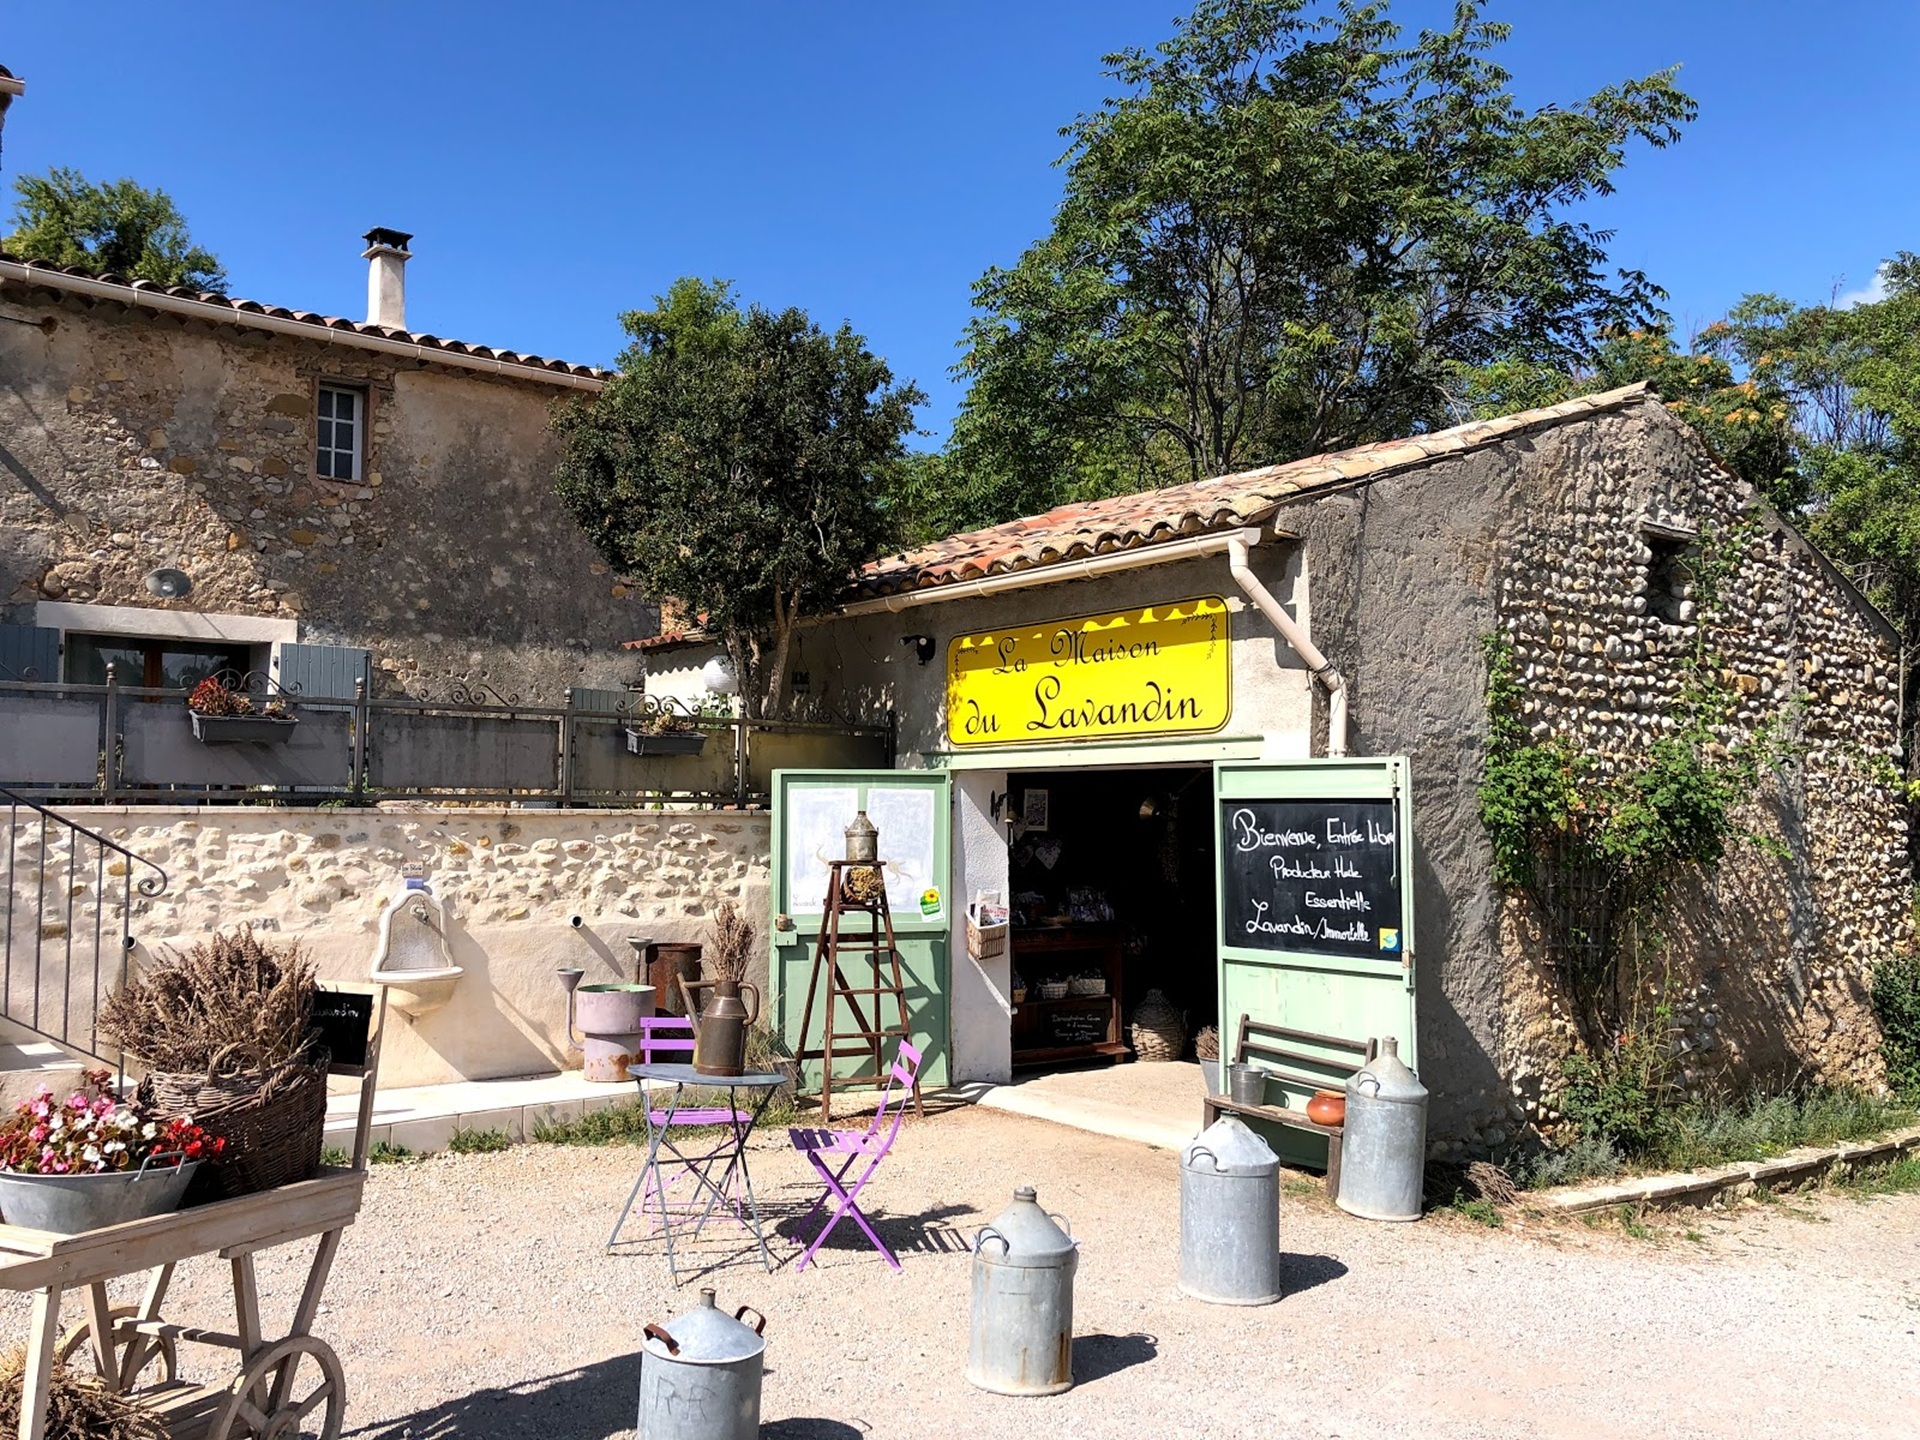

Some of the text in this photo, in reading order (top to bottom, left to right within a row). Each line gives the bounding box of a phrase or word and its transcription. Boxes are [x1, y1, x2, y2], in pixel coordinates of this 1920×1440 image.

[992, 628, 1161, 675] La Maison
[965, 675, 1203, 735] du Lavandin
